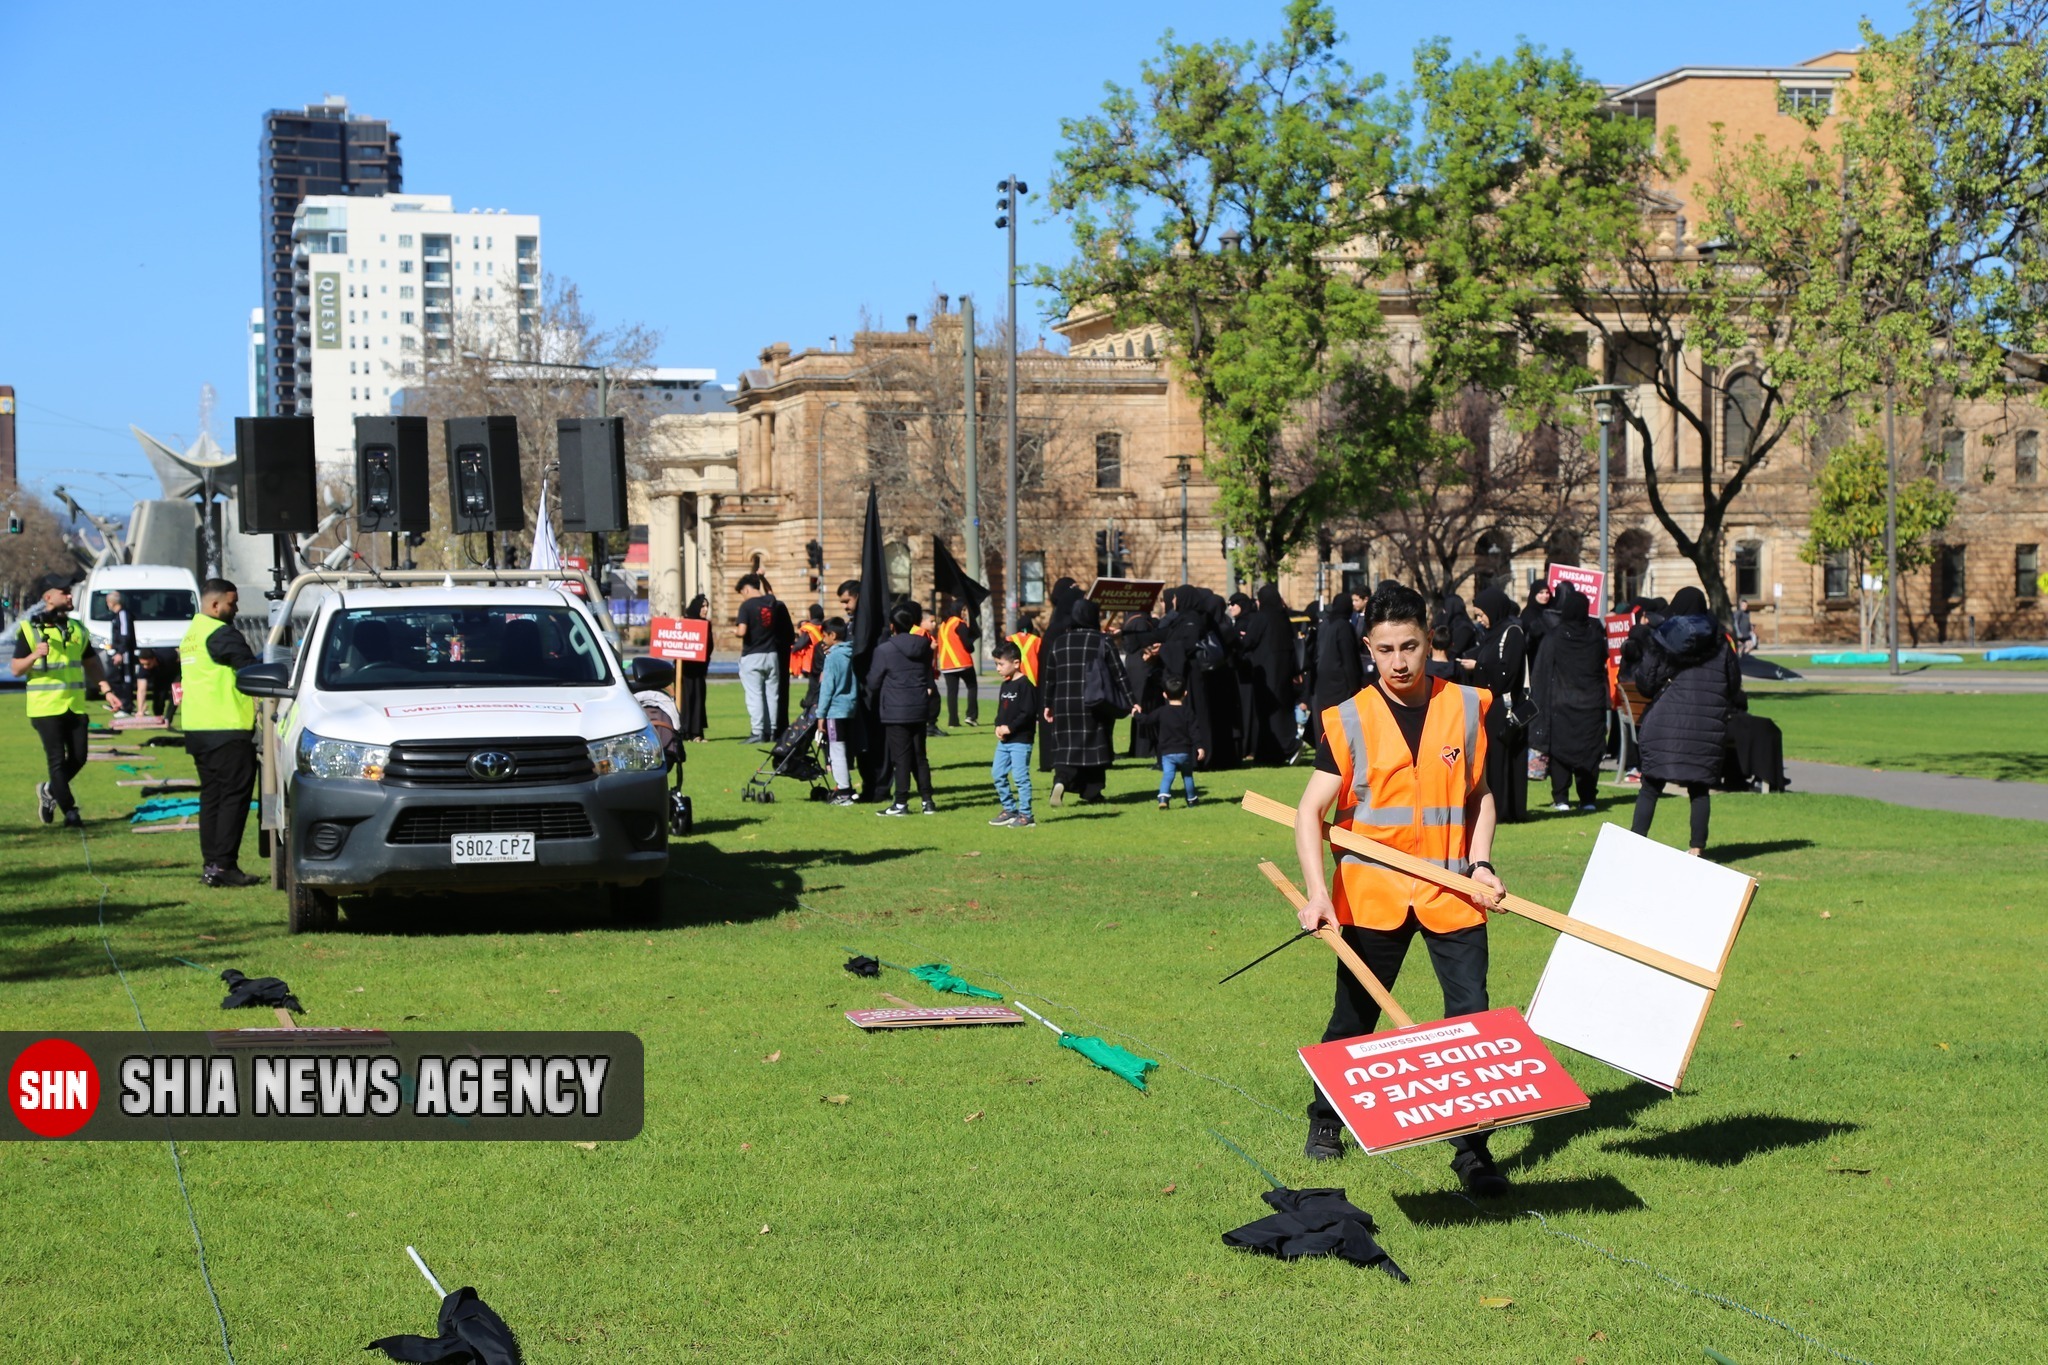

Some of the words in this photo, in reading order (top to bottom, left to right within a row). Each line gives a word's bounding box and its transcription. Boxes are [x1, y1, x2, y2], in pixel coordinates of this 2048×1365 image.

[318, 277, 336, 343] QUEST
[1559, 570, 1594, 583] HUSSAIN
[1100, 590, 1151, 598] HUSSAIN
[1581, 585, 1598, 594] FOR
[674, 622, 682, 630] IS
[1608, 621, 1624, 634] WHO
[1623, 620, 1630, 632] IS
[658, 629, 700, 641] HUSSAIN
[653, 639, 662, 648] IN
[662, 640, 684, 650] YOUR
[684, 642, 704, 651] LIFE?
[402, 703, 564, 713] whoishussain.org
[456, 840, 493, 856] S802
[500, 839, 531, 855] CPZ
[1360, 1026, 1465, 1053] whoishussain.org
[1419, 1037, 1522, 1069] GUIDE
[1343, 1060, 1419, 1086] YOU
[1473, 1058, 1547, 1083] CAN
[1382, 1070, 1473, 1102] SAVE
[1350, 1091, 1377, 1110] &
[1393, 1083, 1542, 1128] HUSSAIN
